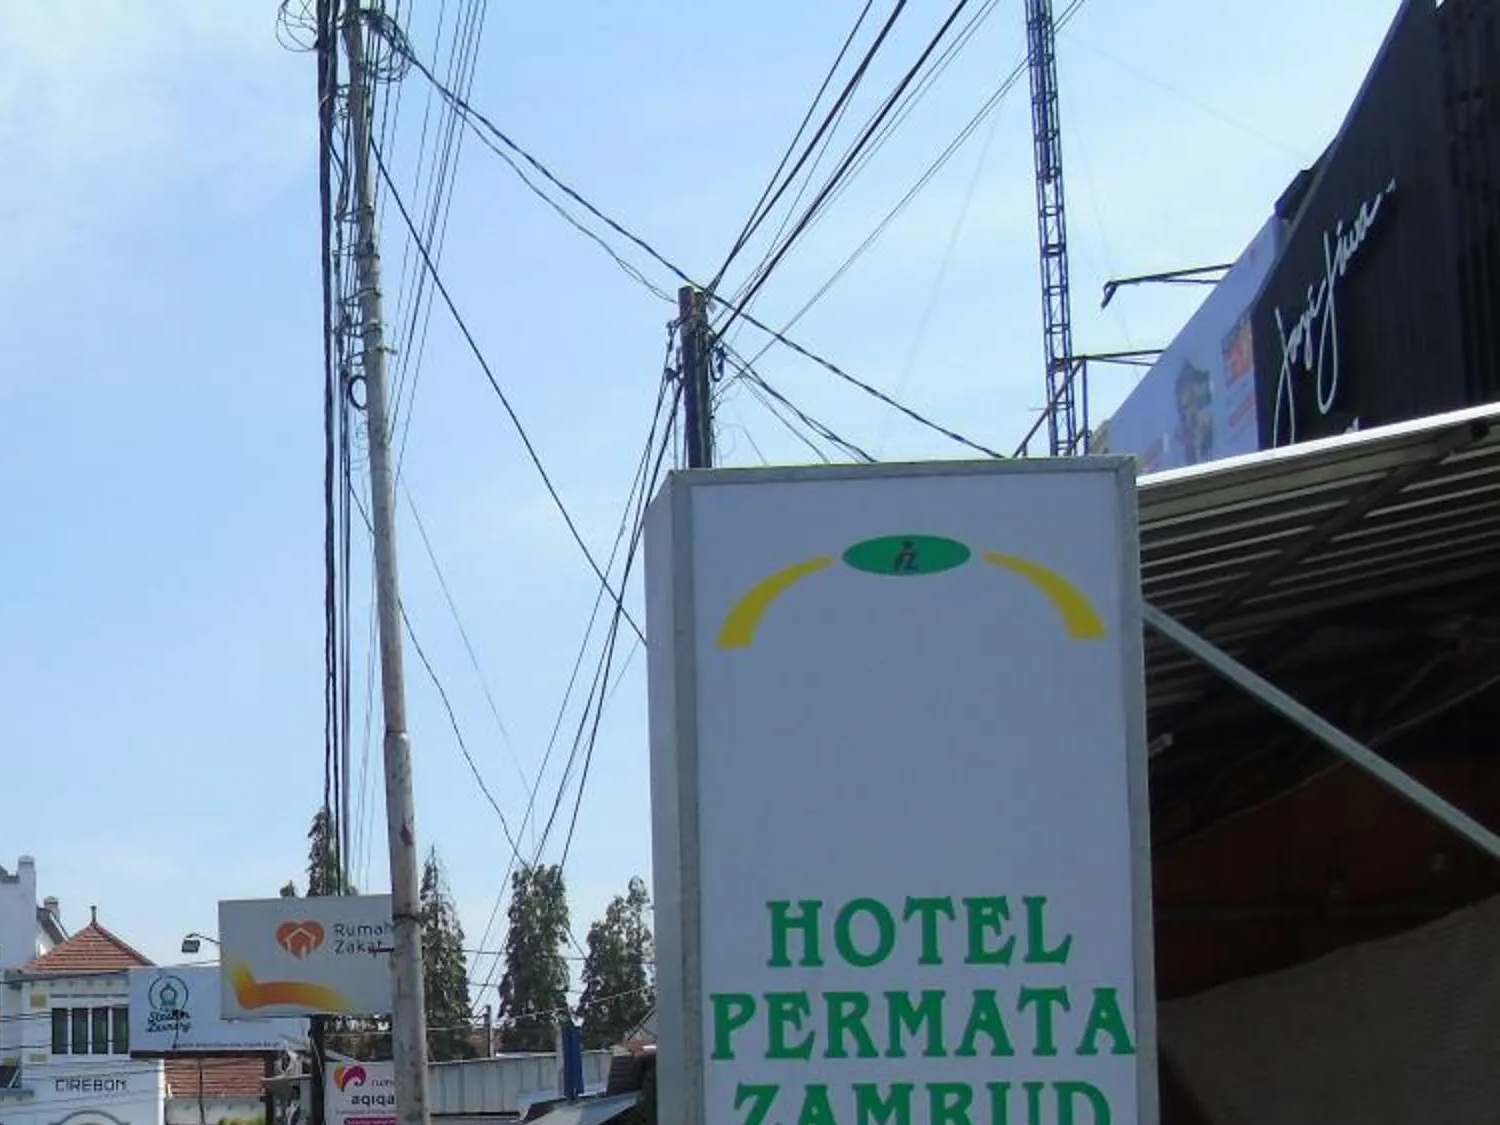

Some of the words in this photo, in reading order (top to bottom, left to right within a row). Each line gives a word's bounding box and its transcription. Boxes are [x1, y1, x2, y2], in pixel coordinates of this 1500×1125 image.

[766, 895, 1072, 968] HOTEL
[709, 986, 1136, 1060] PERMATA
[54, 1078, 127, 1093] CIREBON
[351, 1095, 395, 1107] aqiqa
